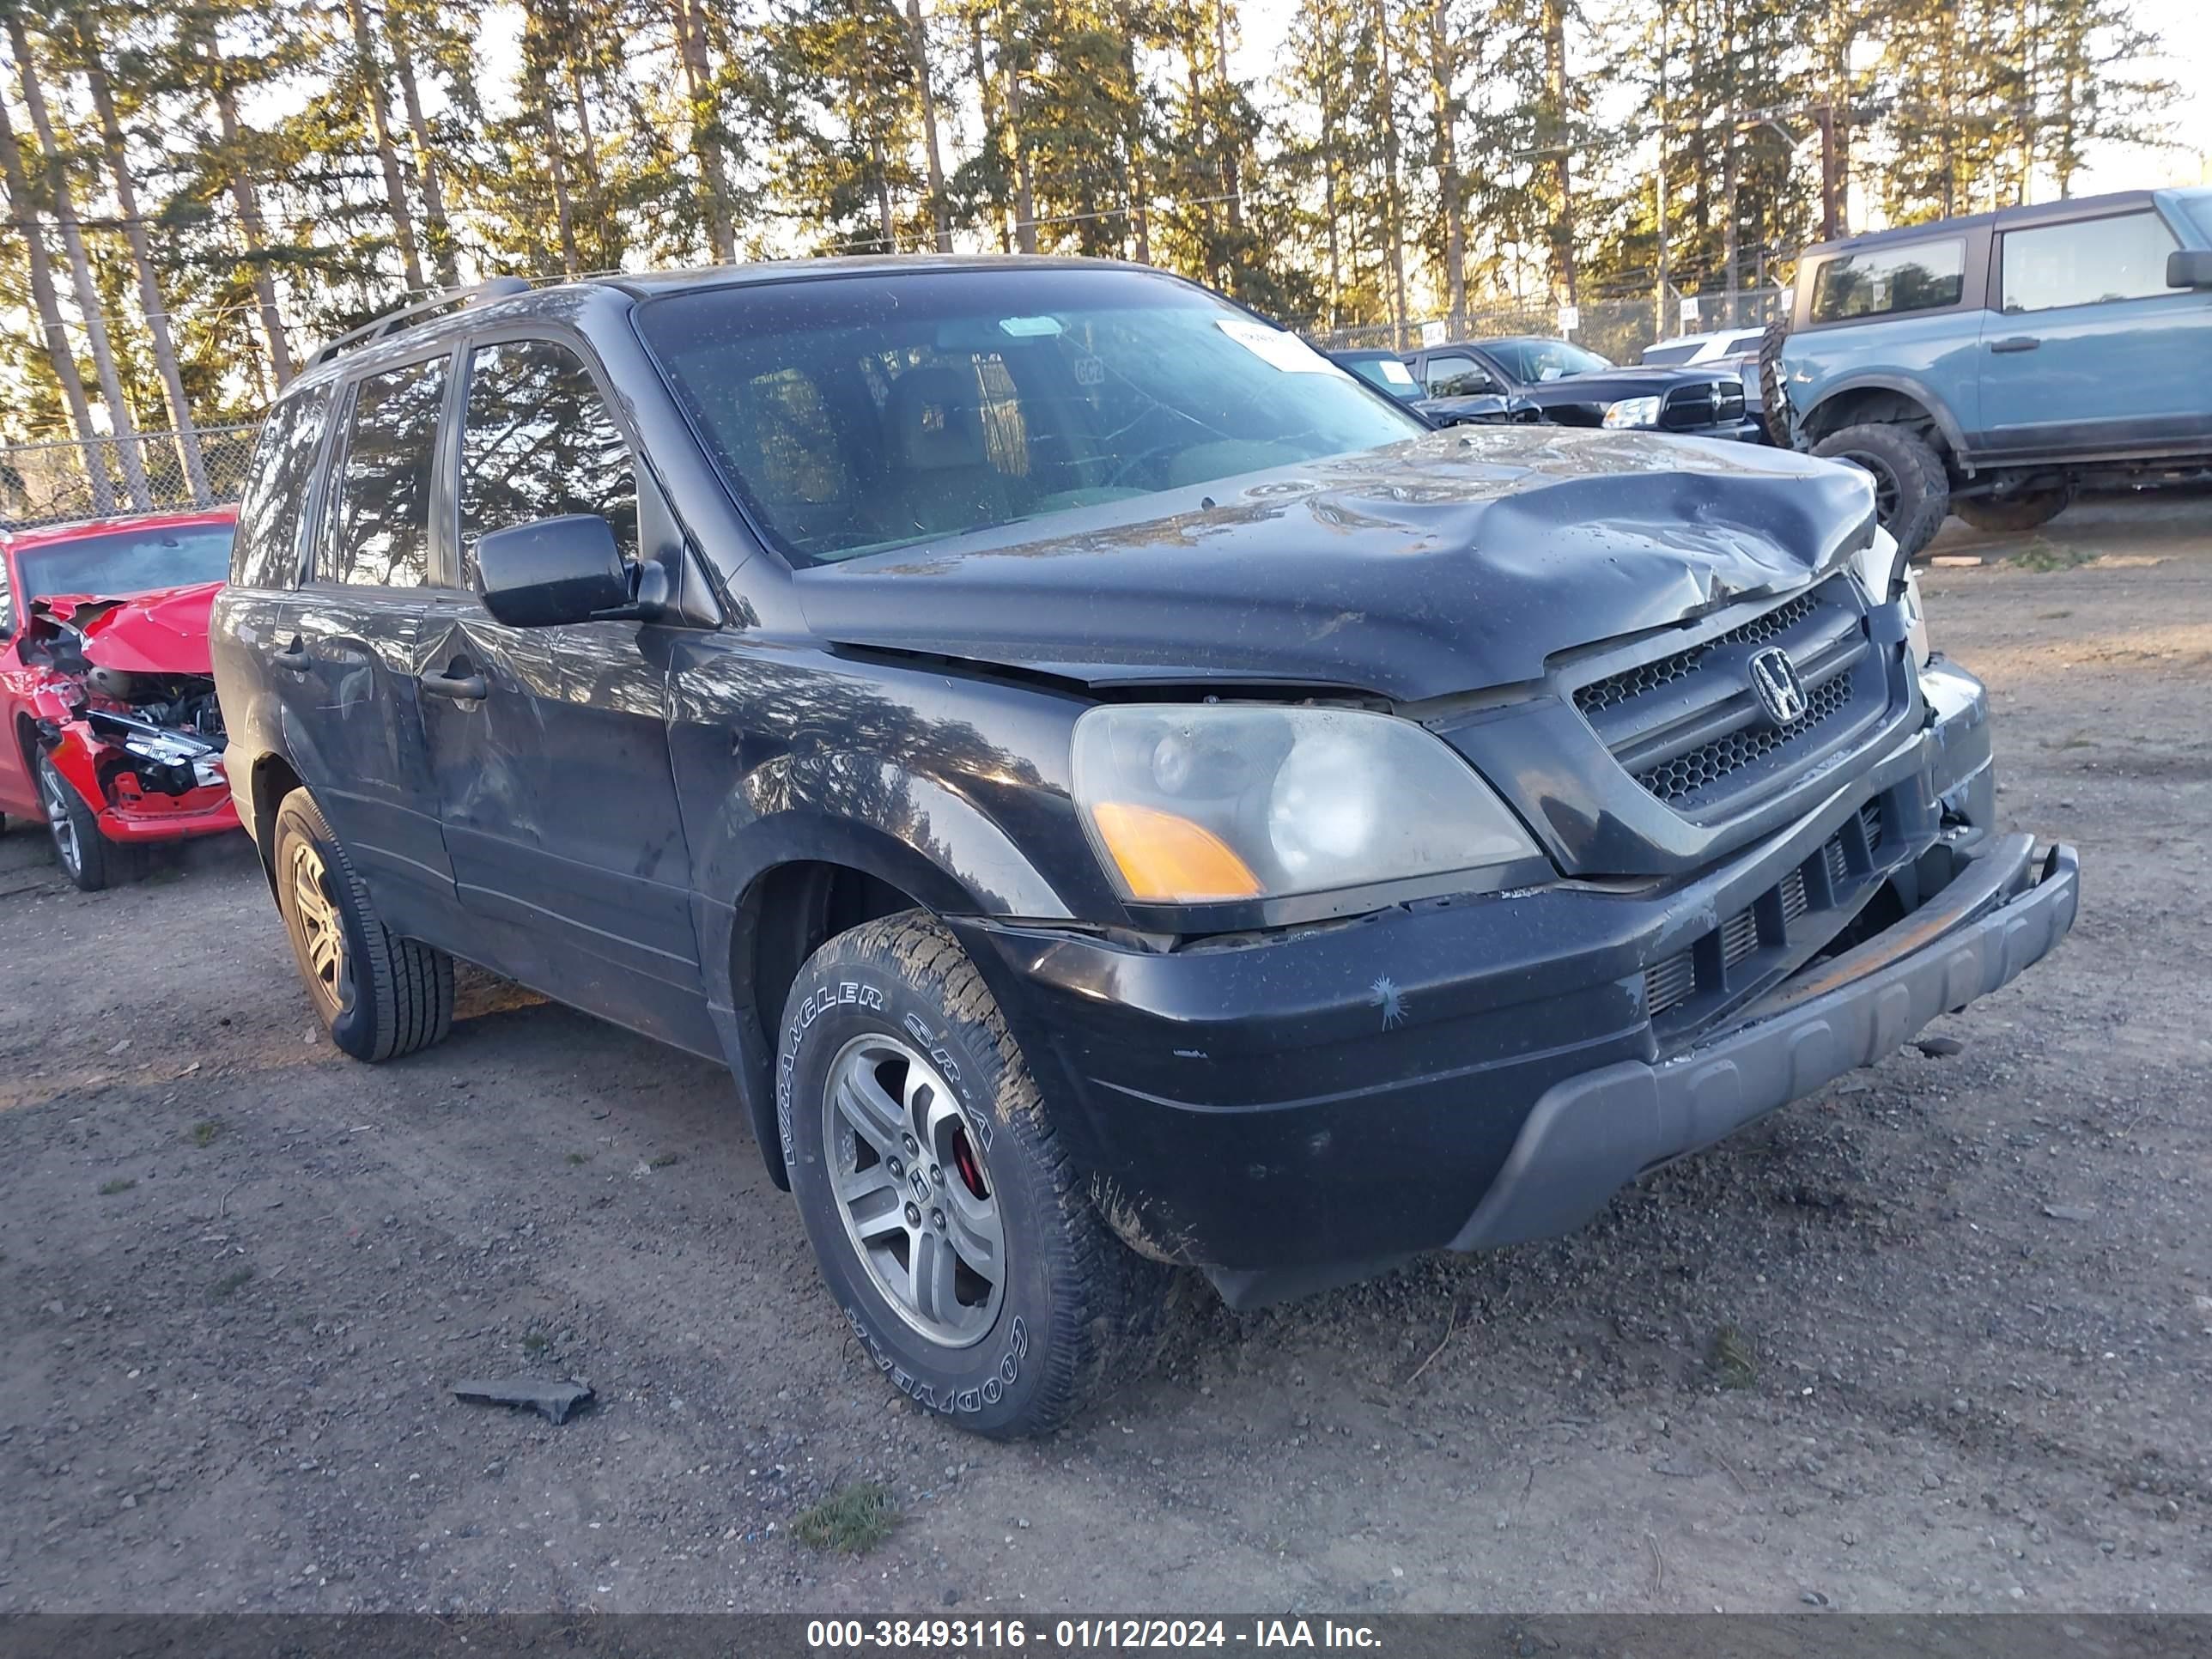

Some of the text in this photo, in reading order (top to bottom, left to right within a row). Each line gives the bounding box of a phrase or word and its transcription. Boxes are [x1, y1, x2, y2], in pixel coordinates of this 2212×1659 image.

[1077, 361, 1103, 384] GC2
[779, 981, 884, 1166] WRANGLER
[843, 1307, 1029, 1414] GOODYEAR
